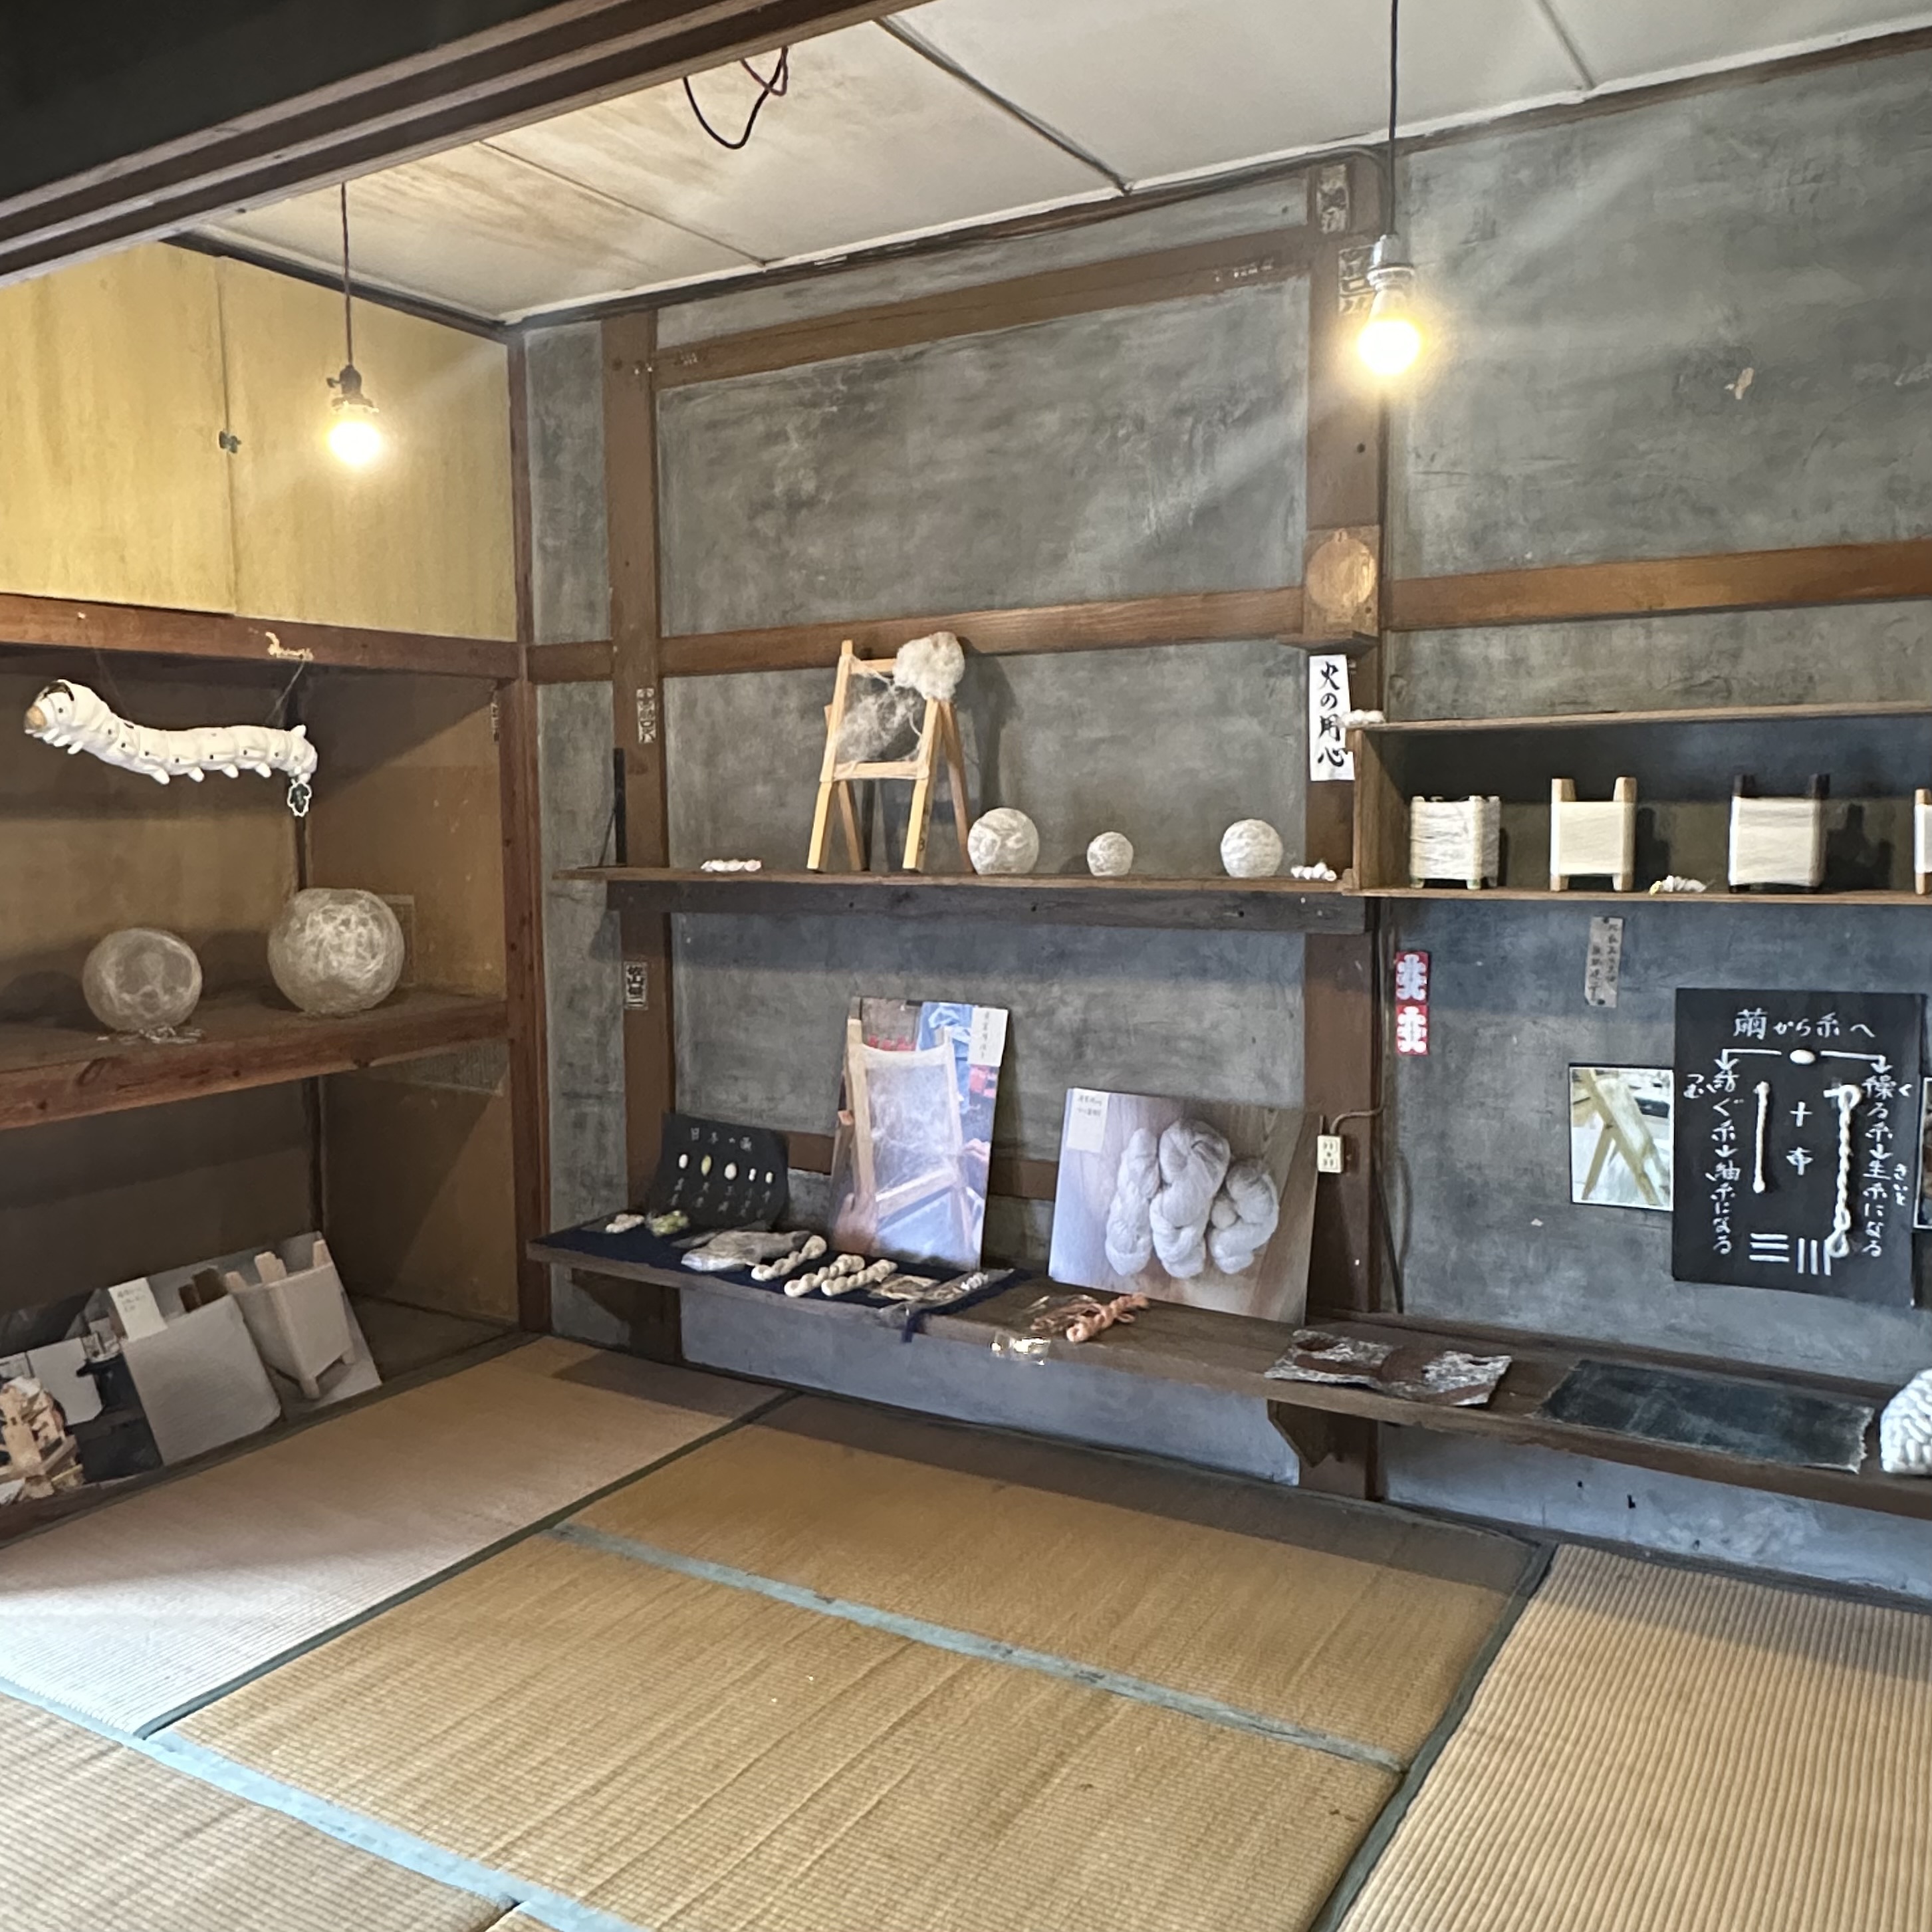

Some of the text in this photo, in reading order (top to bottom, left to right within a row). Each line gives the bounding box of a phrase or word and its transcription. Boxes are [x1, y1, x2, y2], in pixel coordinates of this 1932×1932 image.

[1317, 661, 1348, 767] 火の用心
[1733, 1007, 1876, 1040] 繭から糸へ
